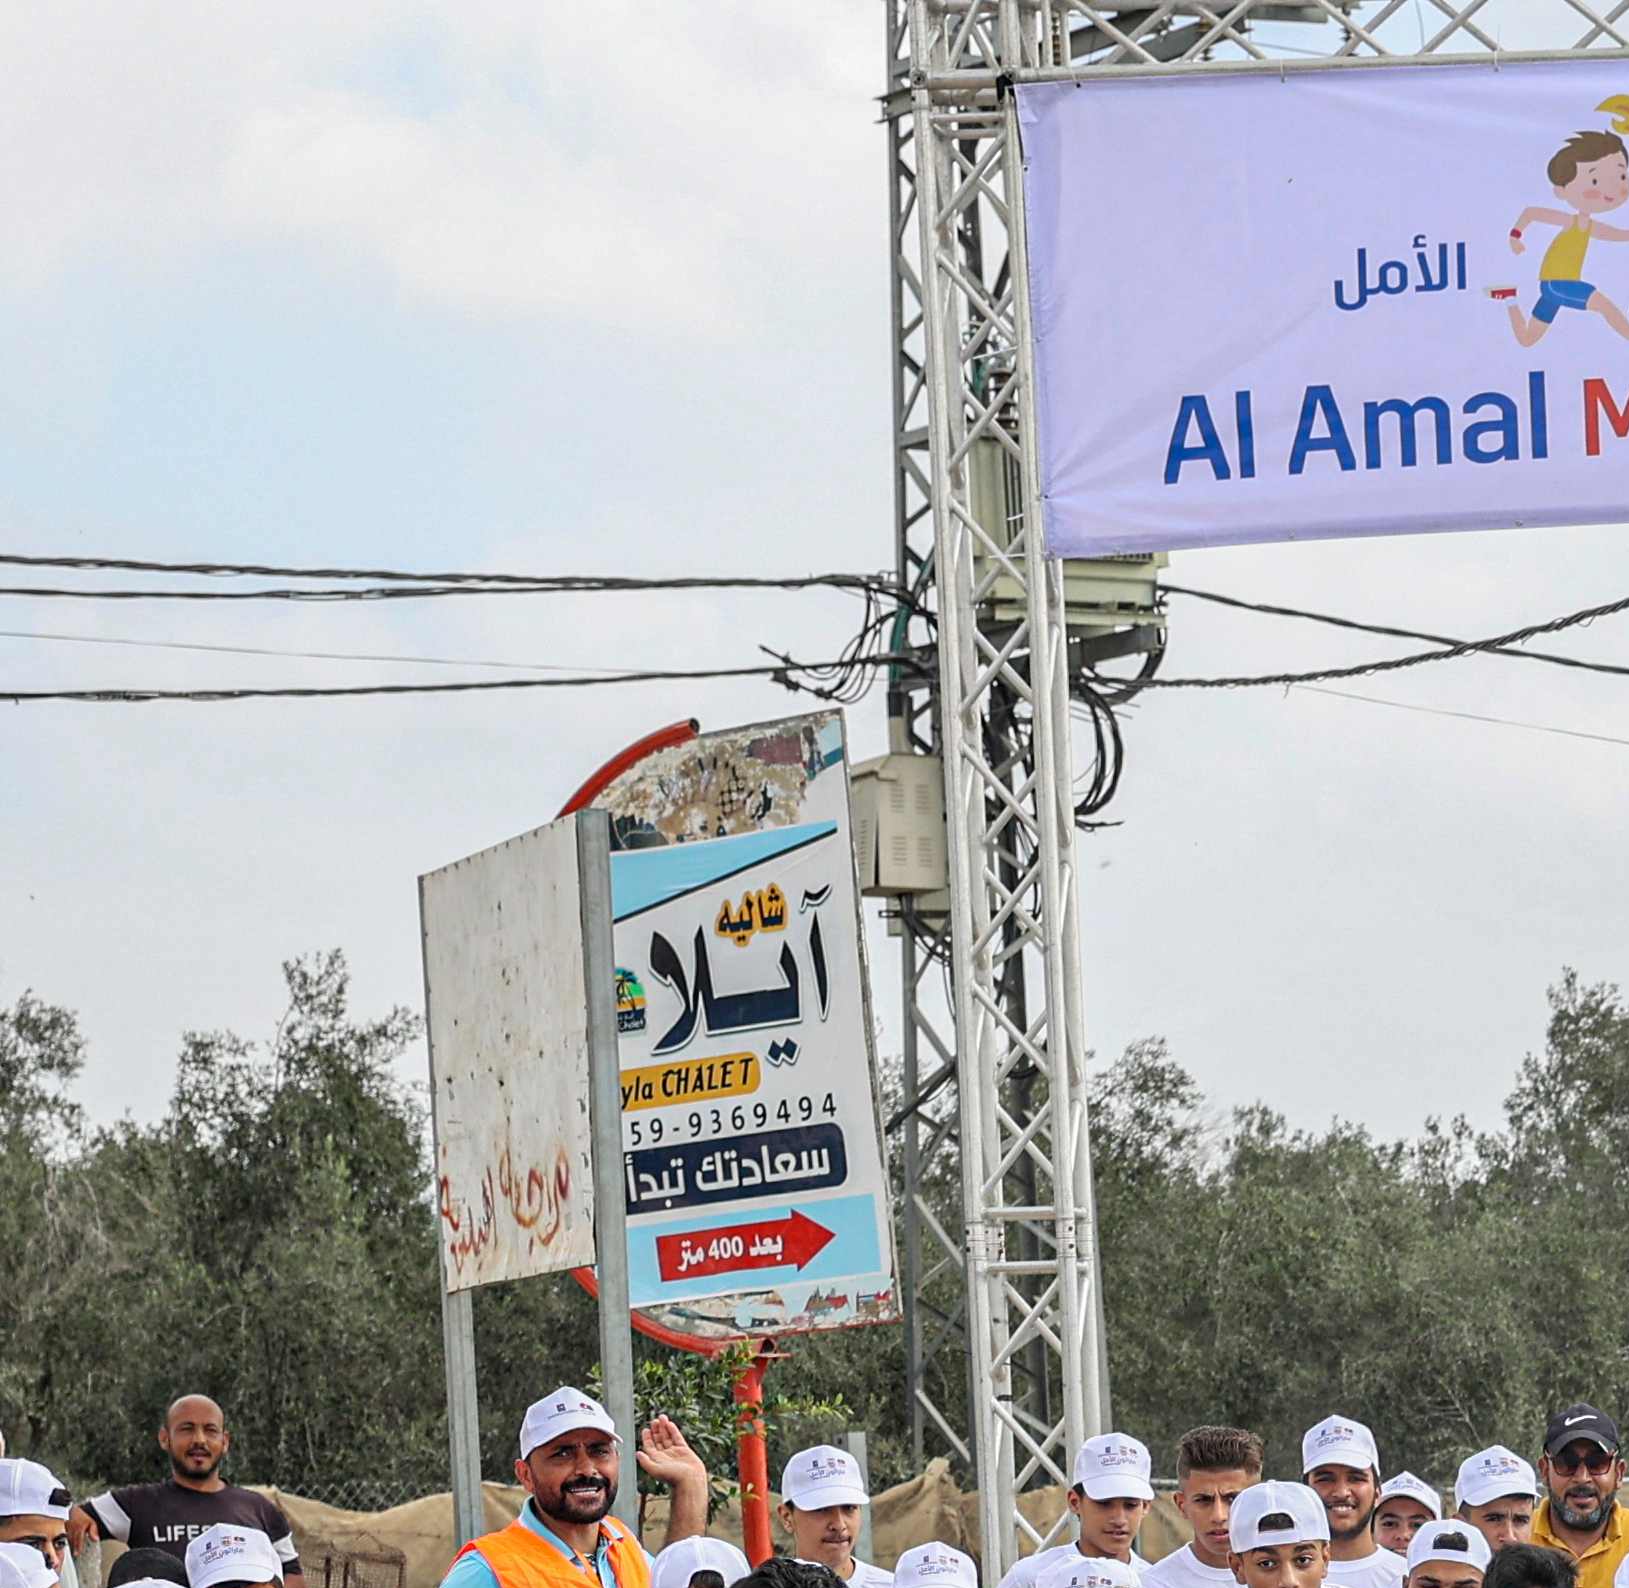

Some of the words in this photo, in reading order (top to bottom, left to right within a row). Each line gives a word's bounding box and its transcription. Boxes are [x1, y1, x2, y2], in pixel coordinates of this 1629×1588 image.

[1333, 235, 1469, 314] الأمل
[1163, 392, 1254, 485] Al
[1287, 370, 1550, 478] Amal
[717, 885, 786, 942] شاليه
[650, 883, 832, 1064] آيلا
[661, 1057, 753, 1098] CHALET
[624, 1153, 686, 1209] تبدأ
[695, 1144, 831, 1193] سعادتك
[677, 1239, 705, 1272] متر
[707, 1236, 744, 1260] 400
[749, 1233, 783, 1261] بعد
